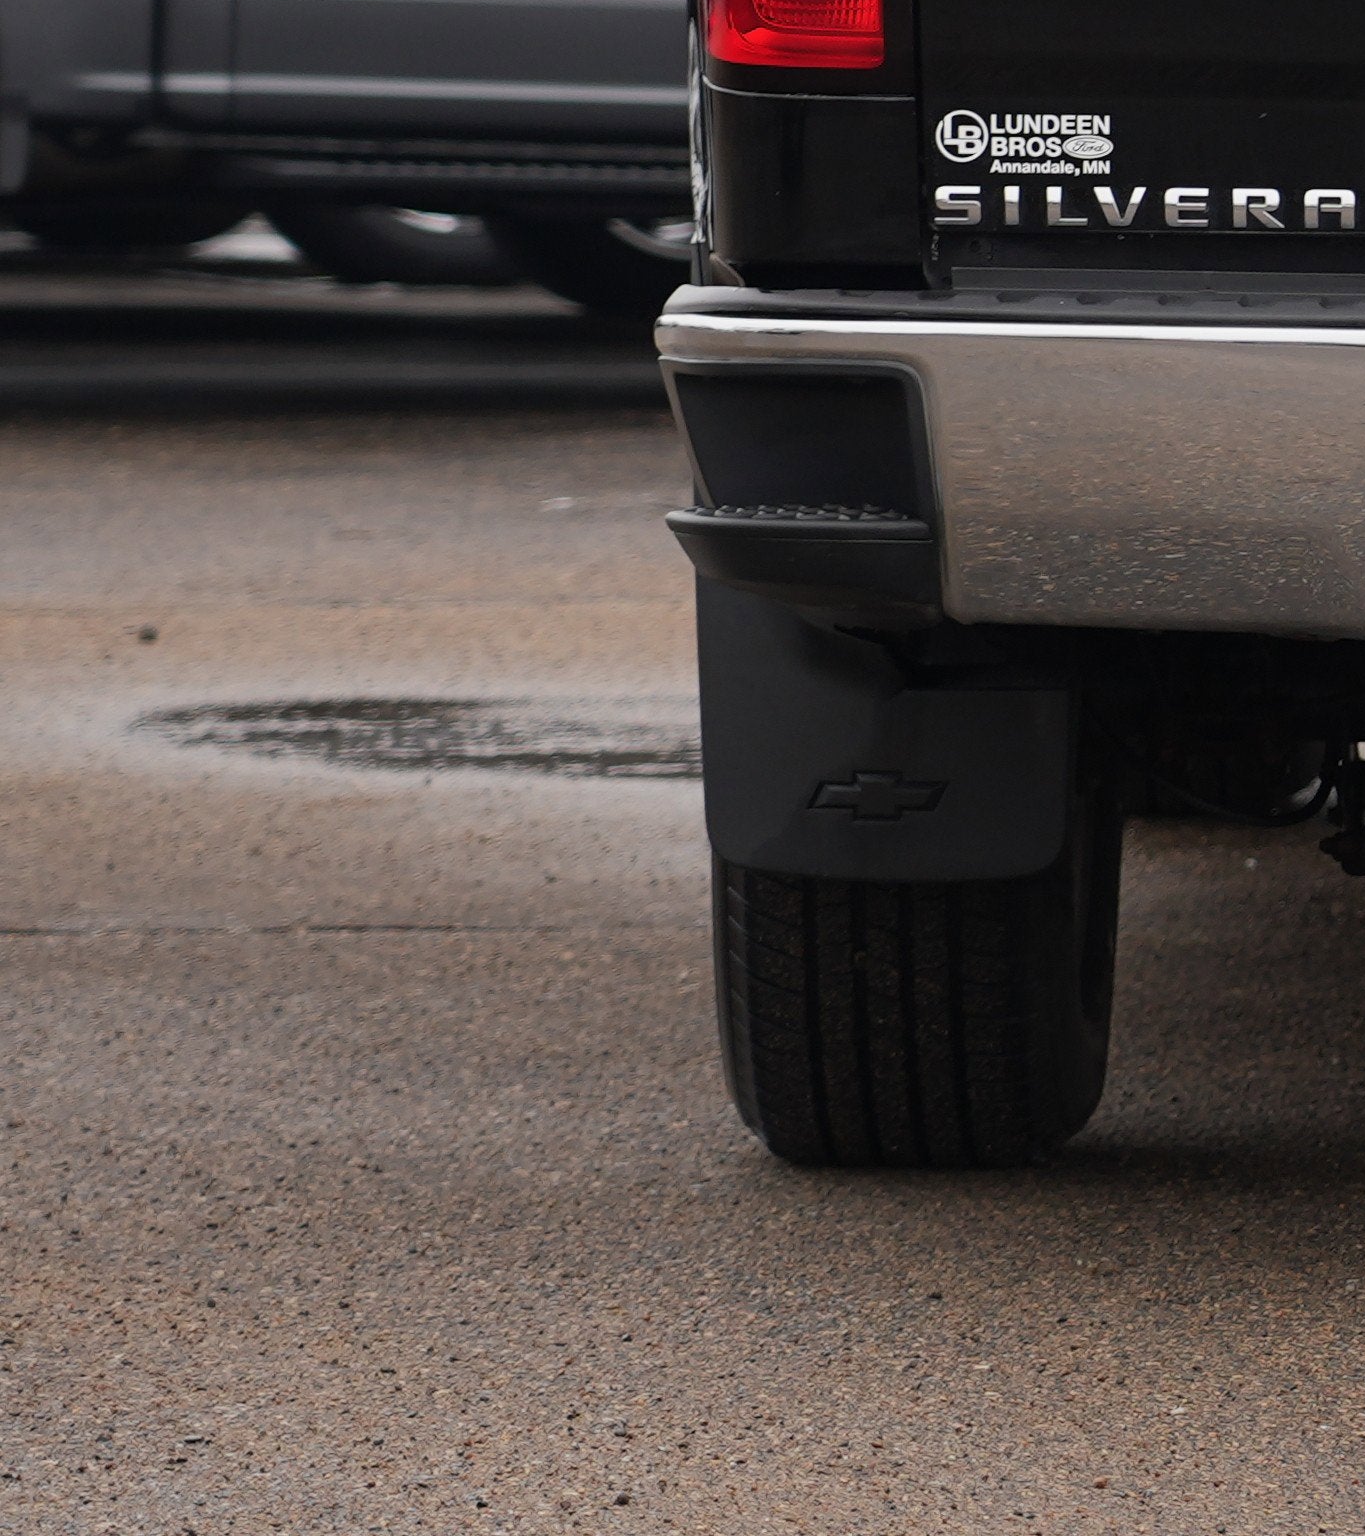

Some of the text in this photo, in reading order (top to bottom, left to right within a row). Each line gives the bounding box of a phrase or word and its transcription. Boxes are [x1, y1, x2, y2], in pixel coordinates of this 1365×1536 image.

[990, 114, 1111, 135] LUNDEEN
[991, 137, 1062, 158] BROS
[990, 160, 1111, 176] Annandale, MN
